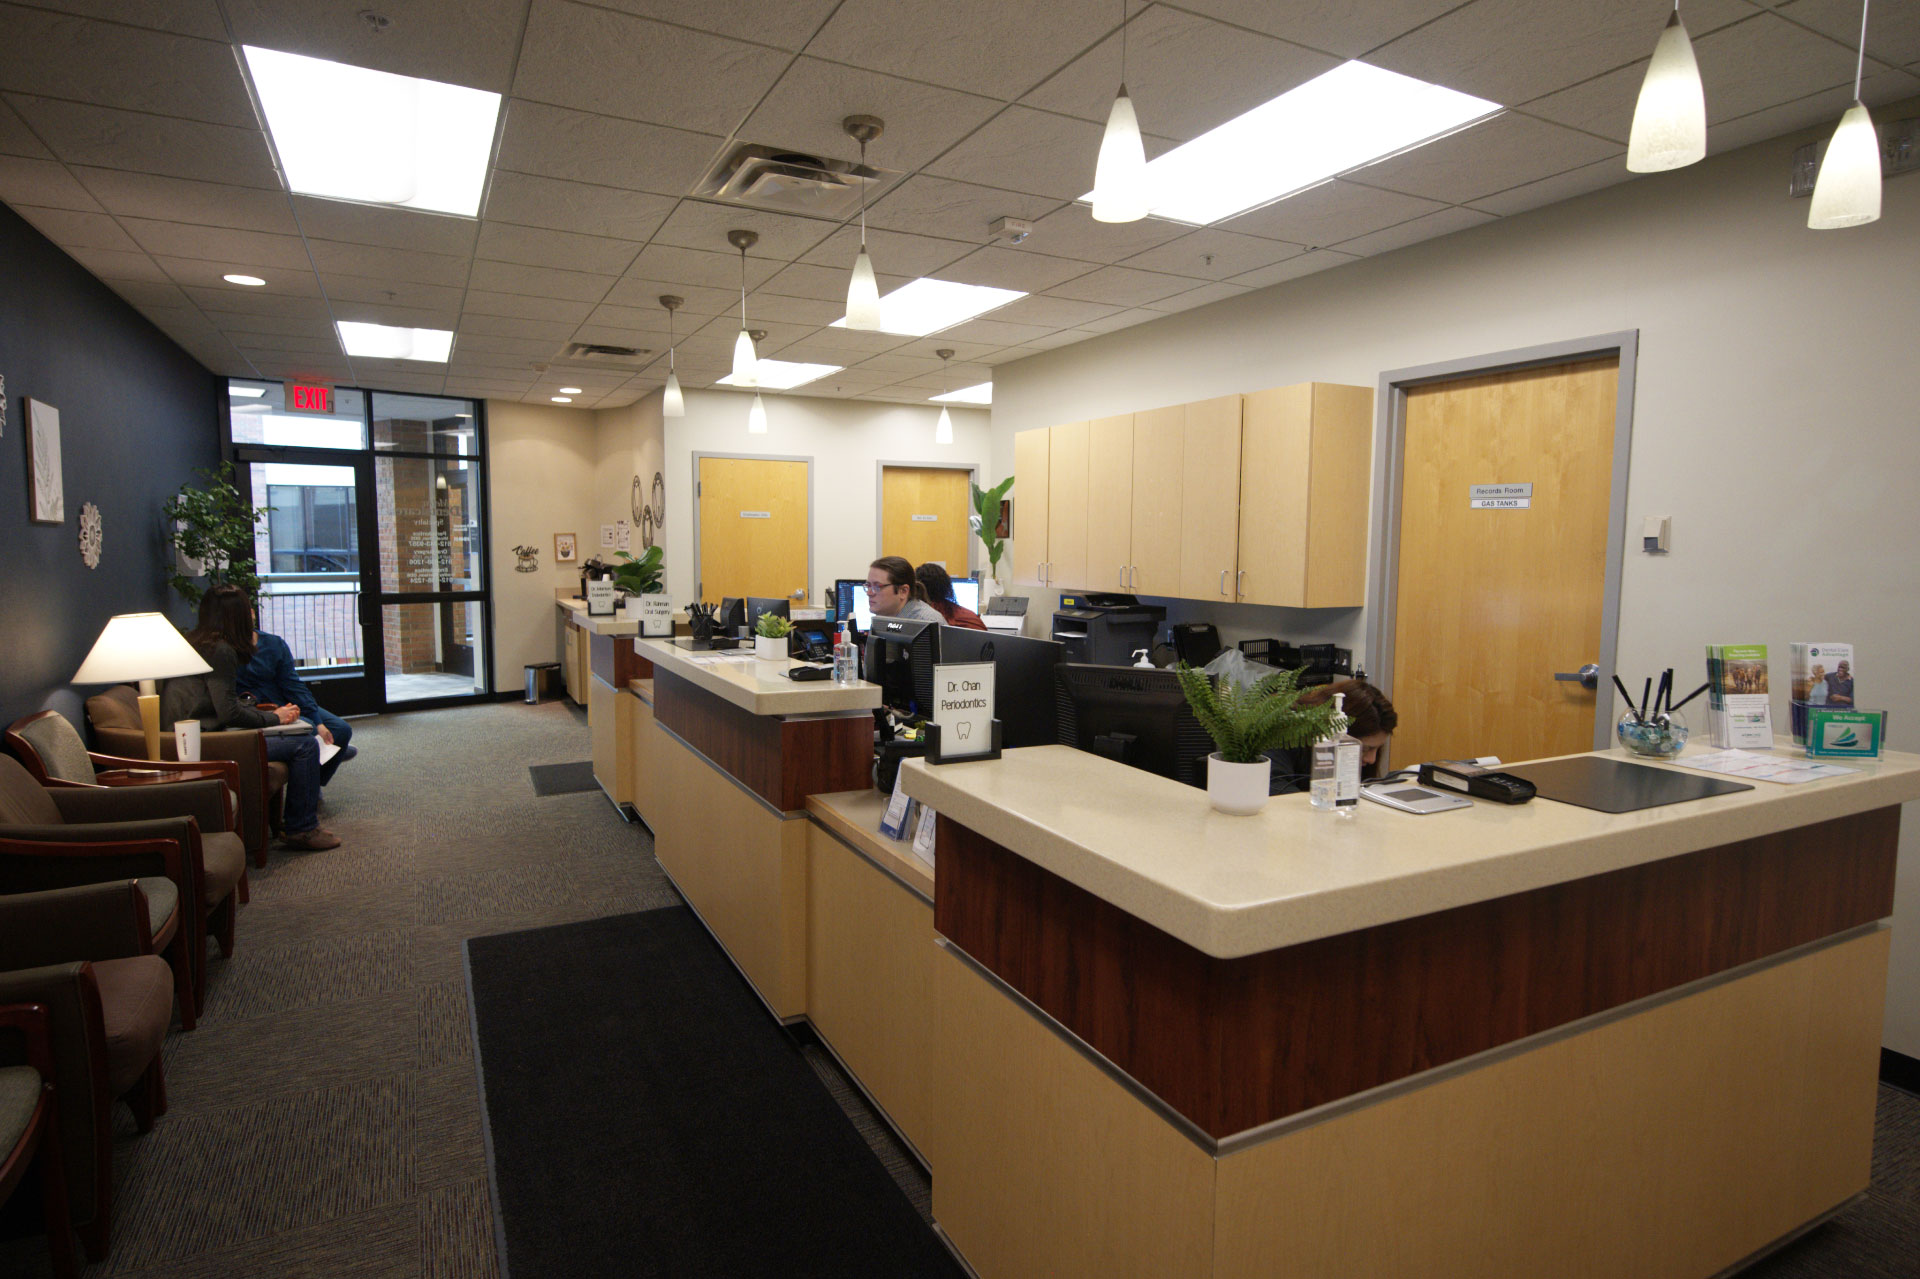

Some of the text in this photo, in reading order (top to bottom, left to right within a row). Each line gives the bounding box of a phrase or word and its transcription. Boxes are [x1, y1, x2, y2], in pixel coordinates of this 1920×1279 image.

[293, 386, 329, 410] EXIT
[1476, 487, 1502, 495] Records
[511, 545, 539, 556] Coffee
[947, 680, 981, 693] Dr. Chan
[941, 698, 987, 711] Periodontics
